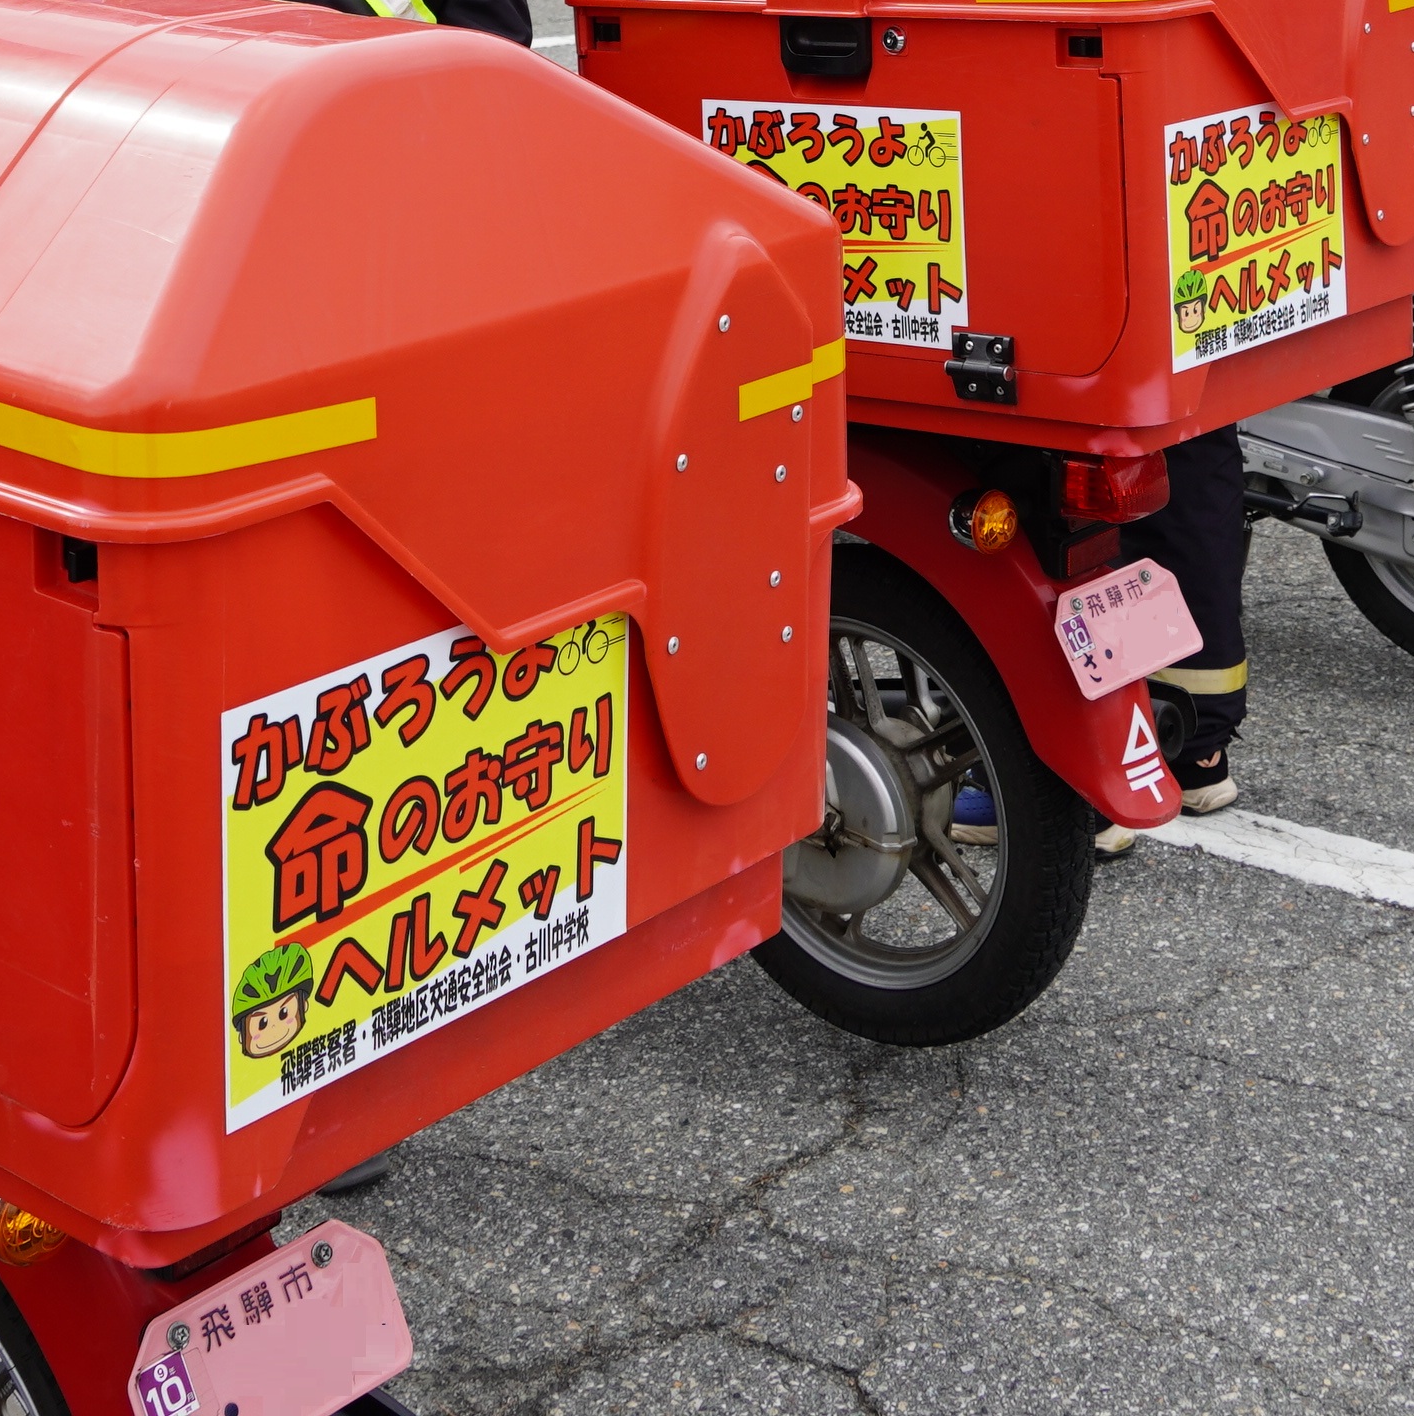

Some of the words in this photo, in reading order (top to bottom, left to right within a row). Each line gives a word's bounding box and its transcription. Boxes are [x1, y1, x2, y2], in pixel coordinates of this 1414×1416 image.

[708, 107, 908, 168] かぶろうよ
[1169, 111, 1308, 185] かぶろうよ
[1185, 164, 1335, 262] 命のお守り
[1209, 237, 1342, 314] ヘルメット
[232, 637, 559, 811] かぶろうよ
[266, 692, 612, 933] 命のお守り
[315, 816, 622, 1007] ヘルメット
